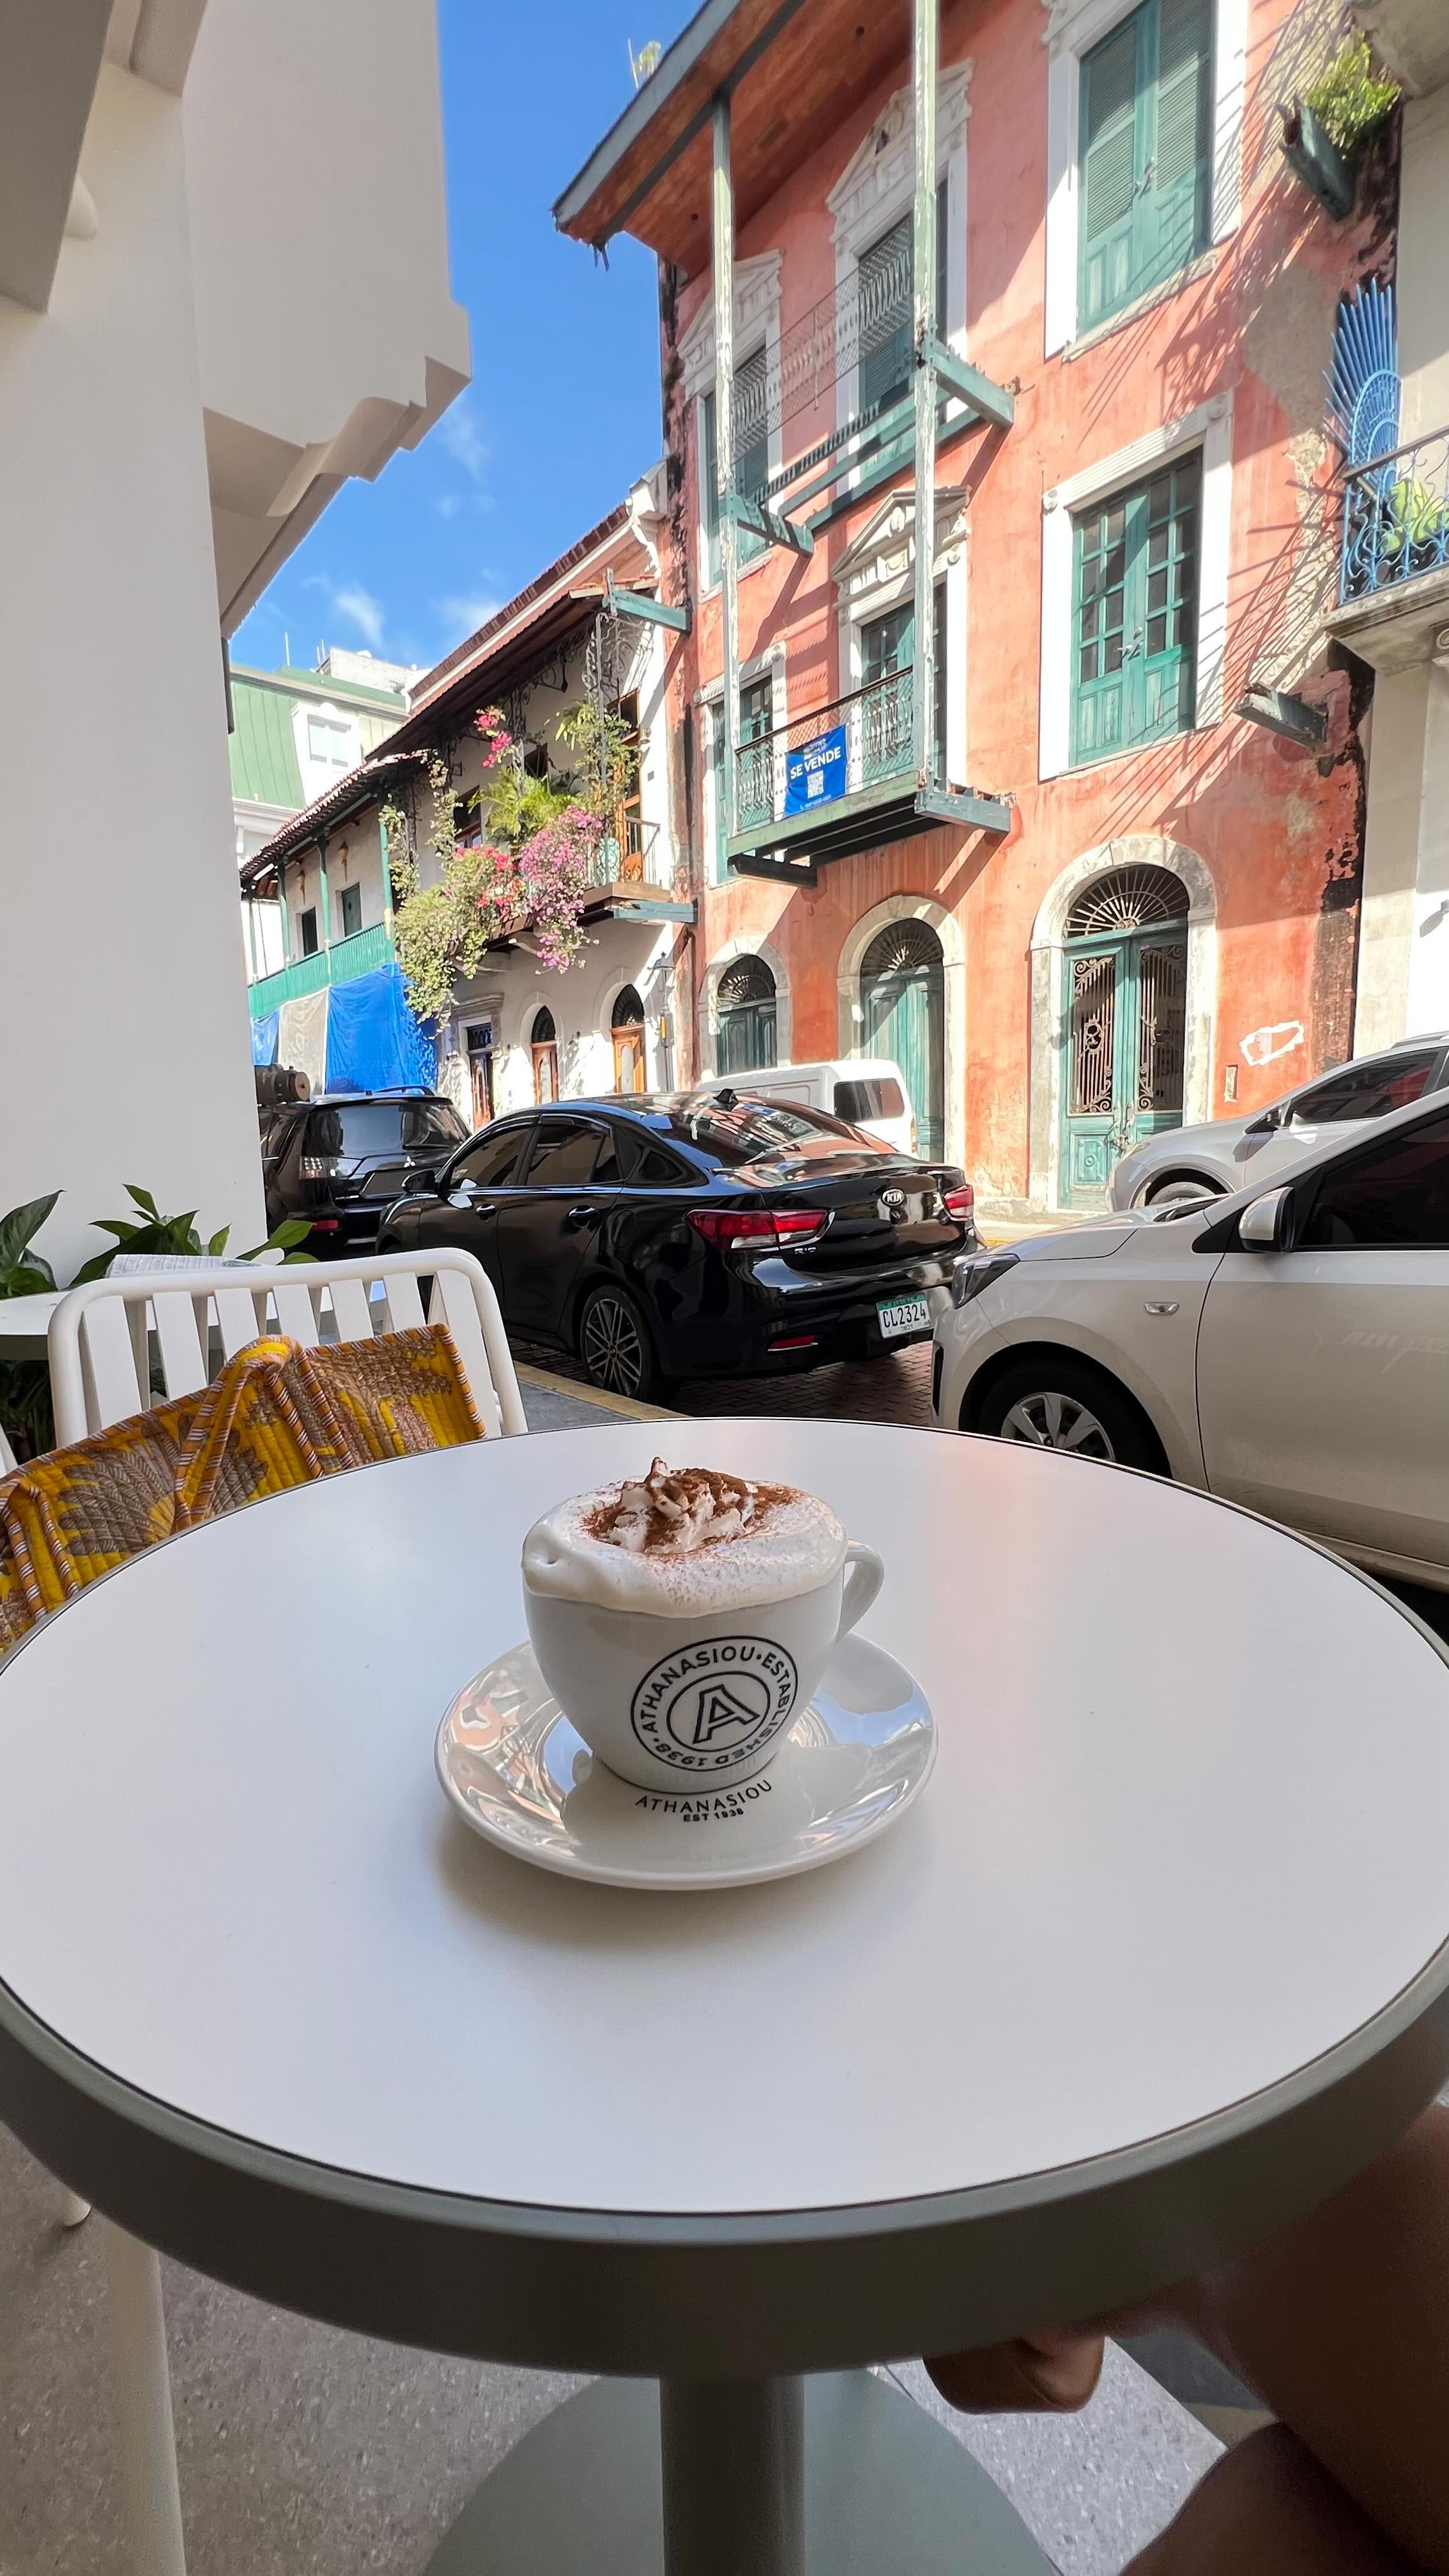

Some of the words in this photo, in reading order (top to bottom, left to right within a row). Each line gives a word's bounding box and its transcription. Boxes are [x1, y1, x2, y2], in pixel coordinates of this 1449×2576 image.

[790, 763, 803, 779] SE
[804, 746, 841, 772] VENDE
[886, 1192, 901, 1202] KIA
[882, 1303, 926, 1328] CL2324
[640, 1646, 756, 1733] ATHANASIOU
[692, 1683, 760, 1745] A
[714, 1652, 791, 1765] ESTABLISHED
[656, 1742, 708, 1766] 1938
[634, 1779, 772, 1813] ATHANASIOU
[683, 1813, 710, 1822] EST
[714, 1807, 744, 1820] 1938
